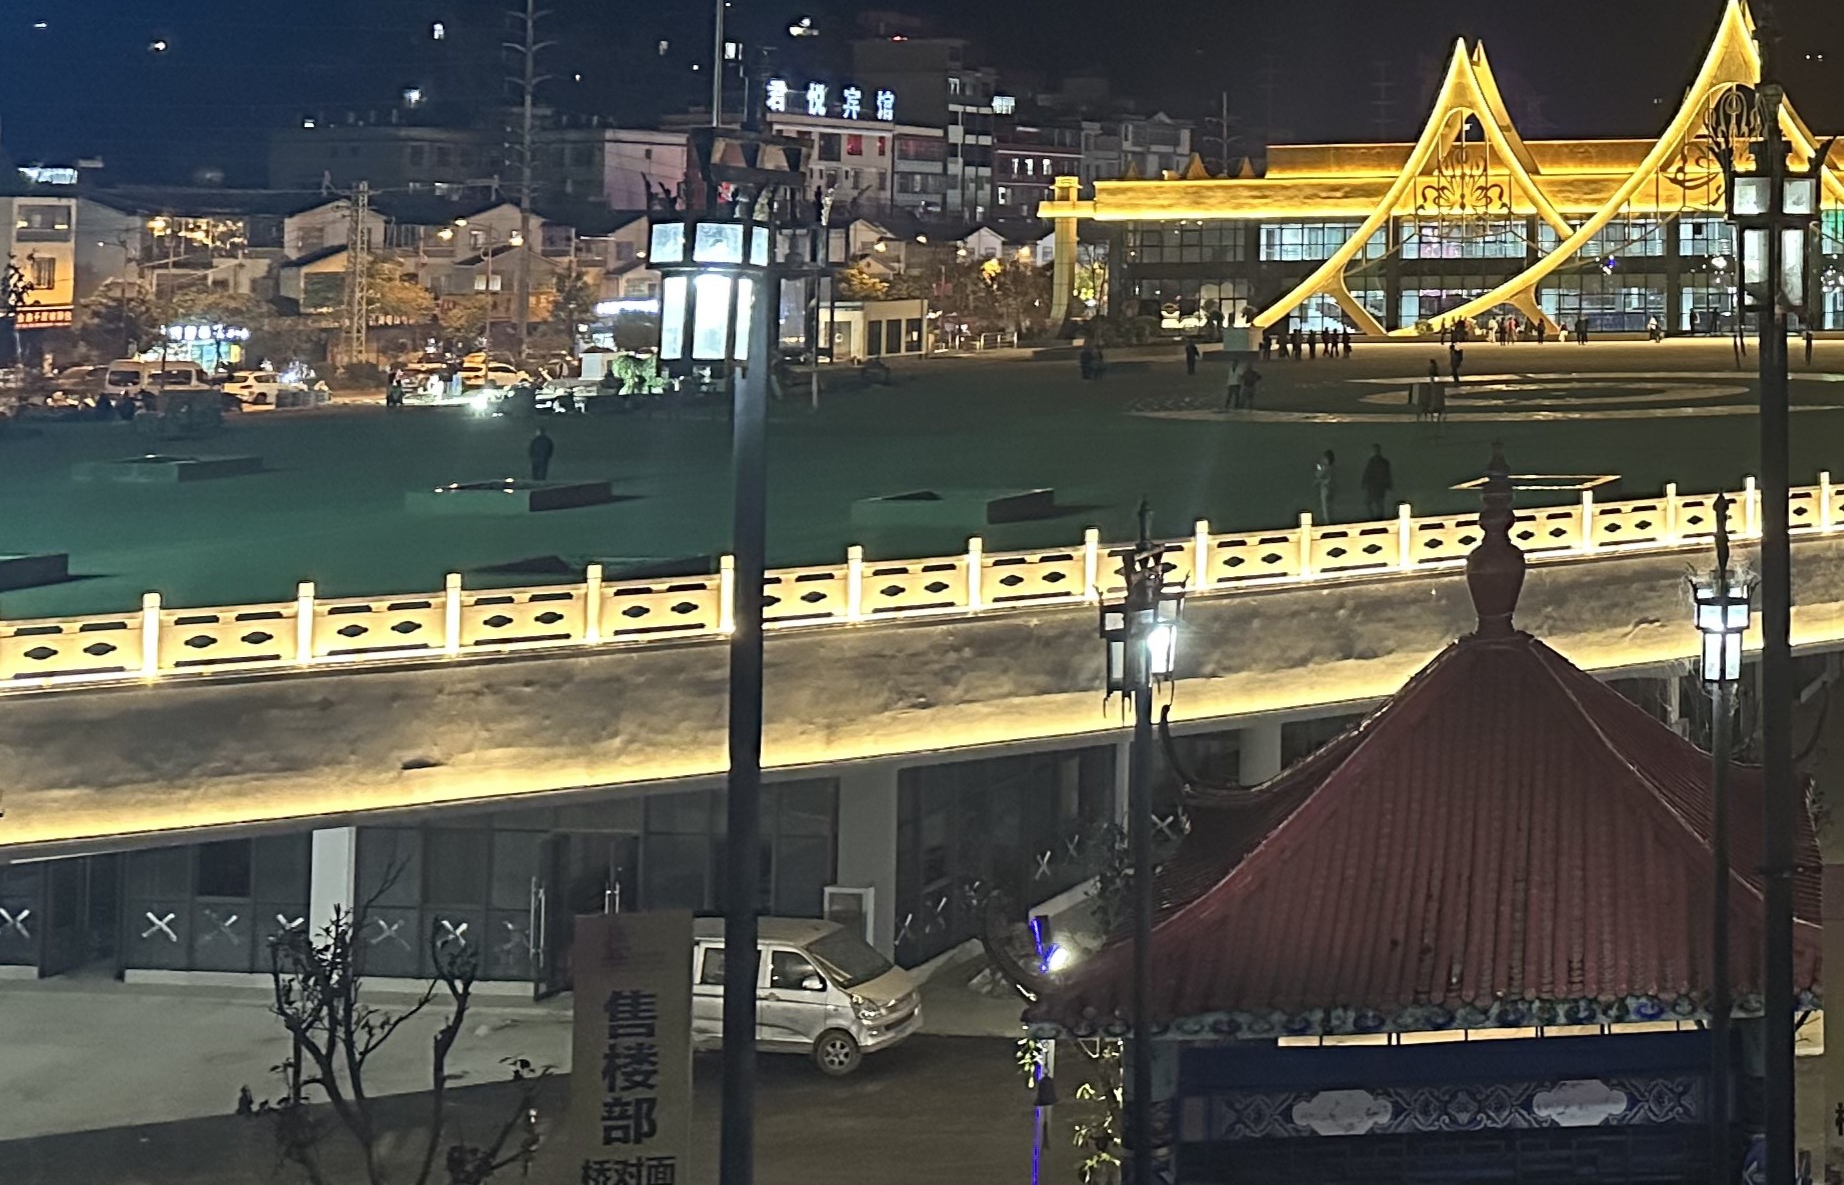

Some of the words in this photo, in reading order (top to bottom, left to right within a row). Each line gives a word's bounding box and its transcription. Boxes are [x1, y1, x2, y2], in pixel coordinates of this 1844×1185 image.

[766, 79, 895, 120] 君悦宾馆
[602, 989, 658, 1146] 售楼部
[581, 1156, 677, 1185] 桥对面
